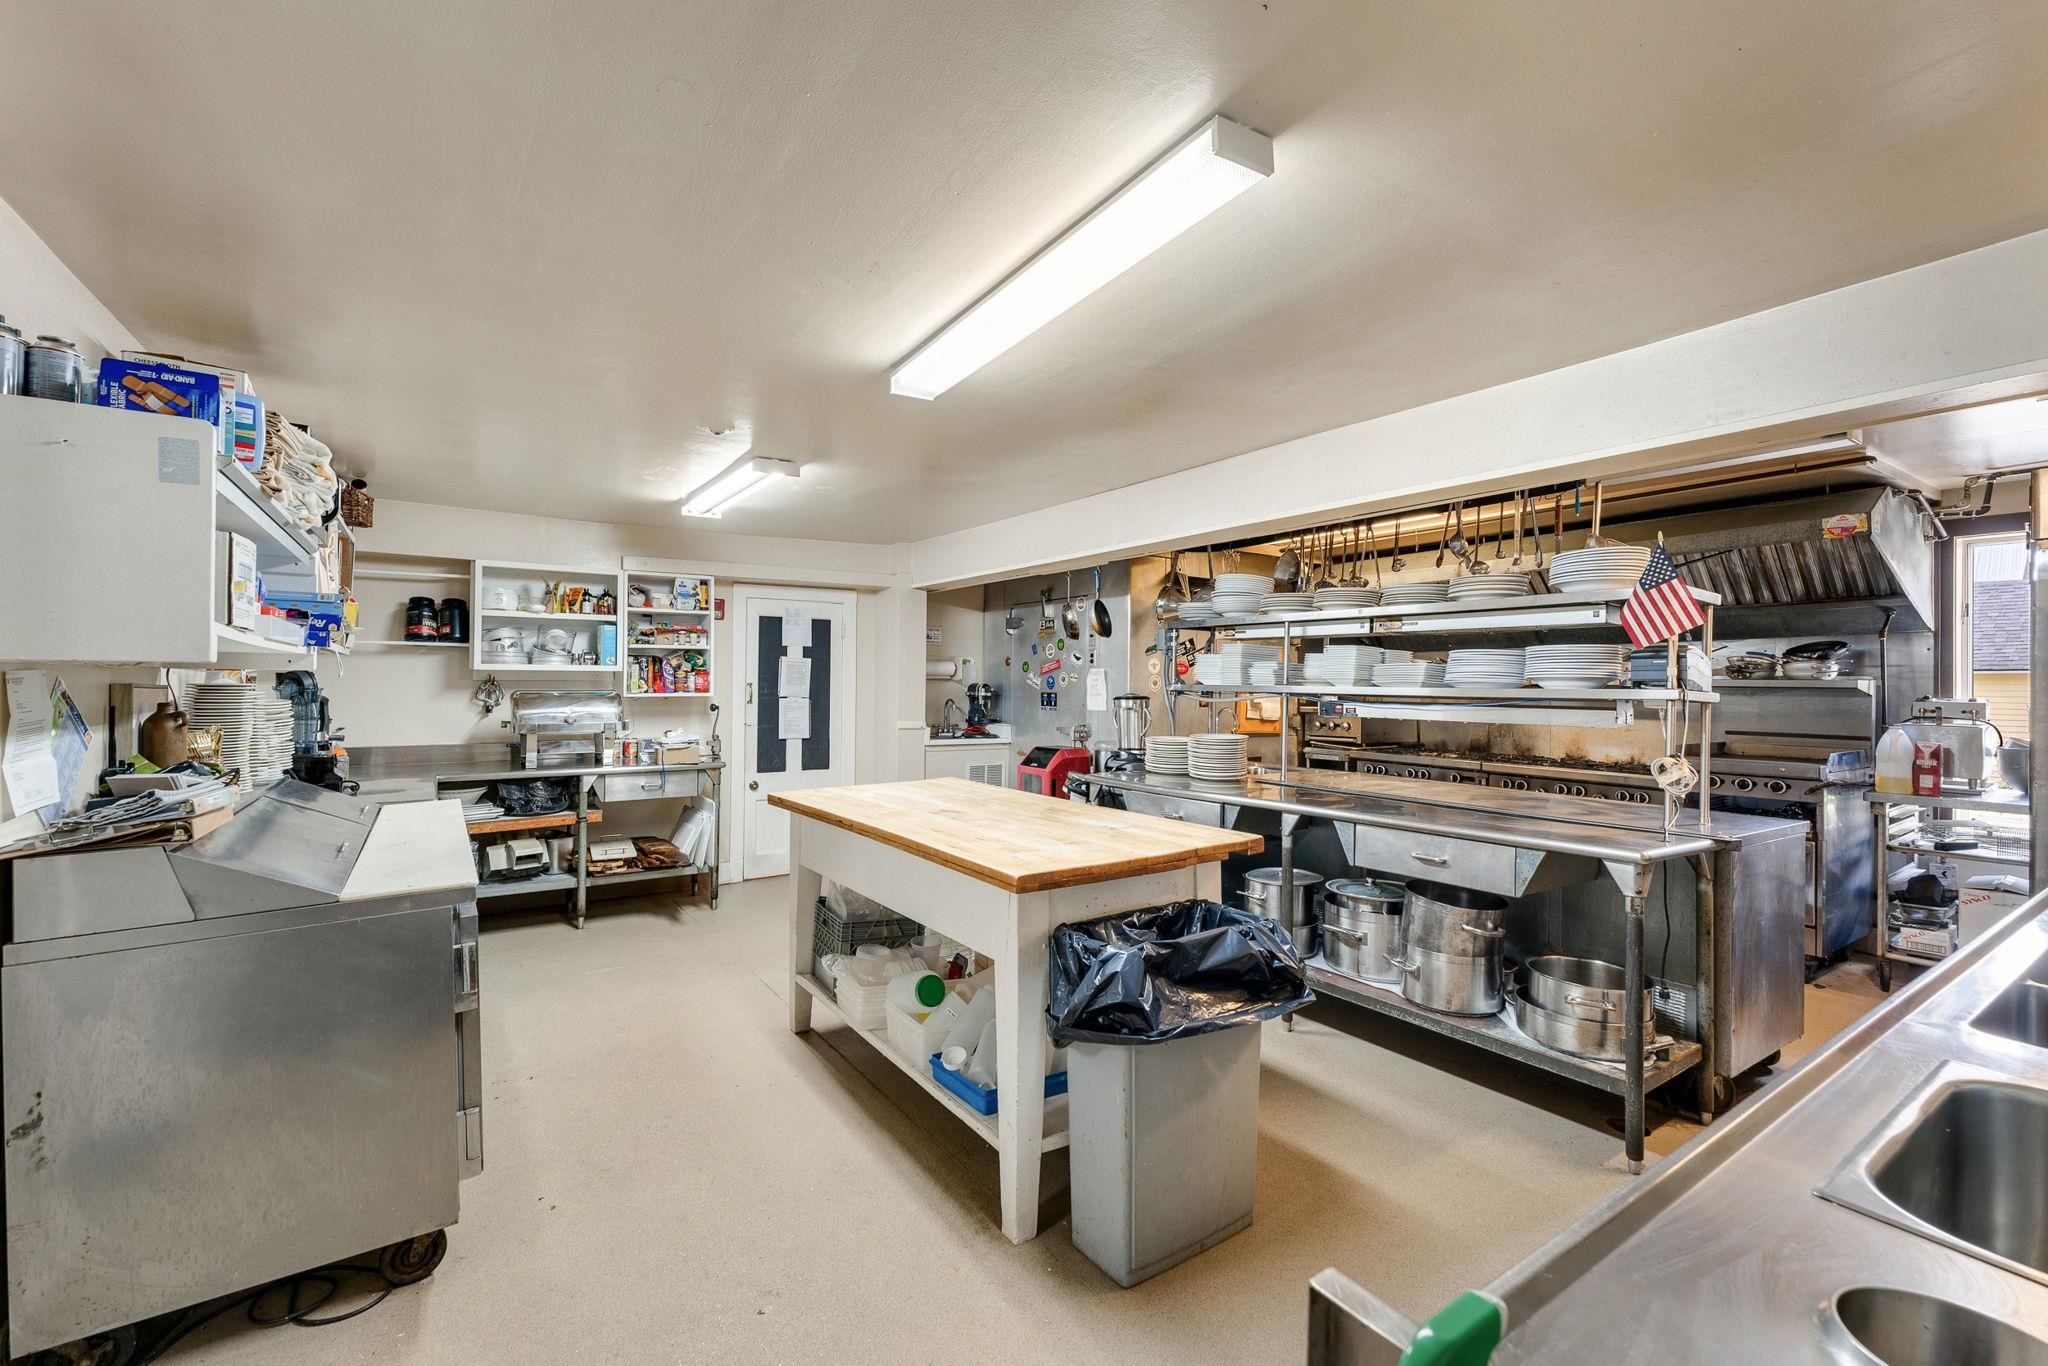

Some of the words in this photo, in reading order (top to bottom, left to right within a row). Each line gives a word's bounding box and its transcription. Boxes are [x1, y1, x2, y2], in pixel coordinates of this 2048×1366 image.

[160, 372, 196, 384] BAND-AID
[109, 381, 119, 408] LEXIBLE
[118, 389, 127, 409] ABRIC
[1960, 894, 1991, 905] SYSCO
